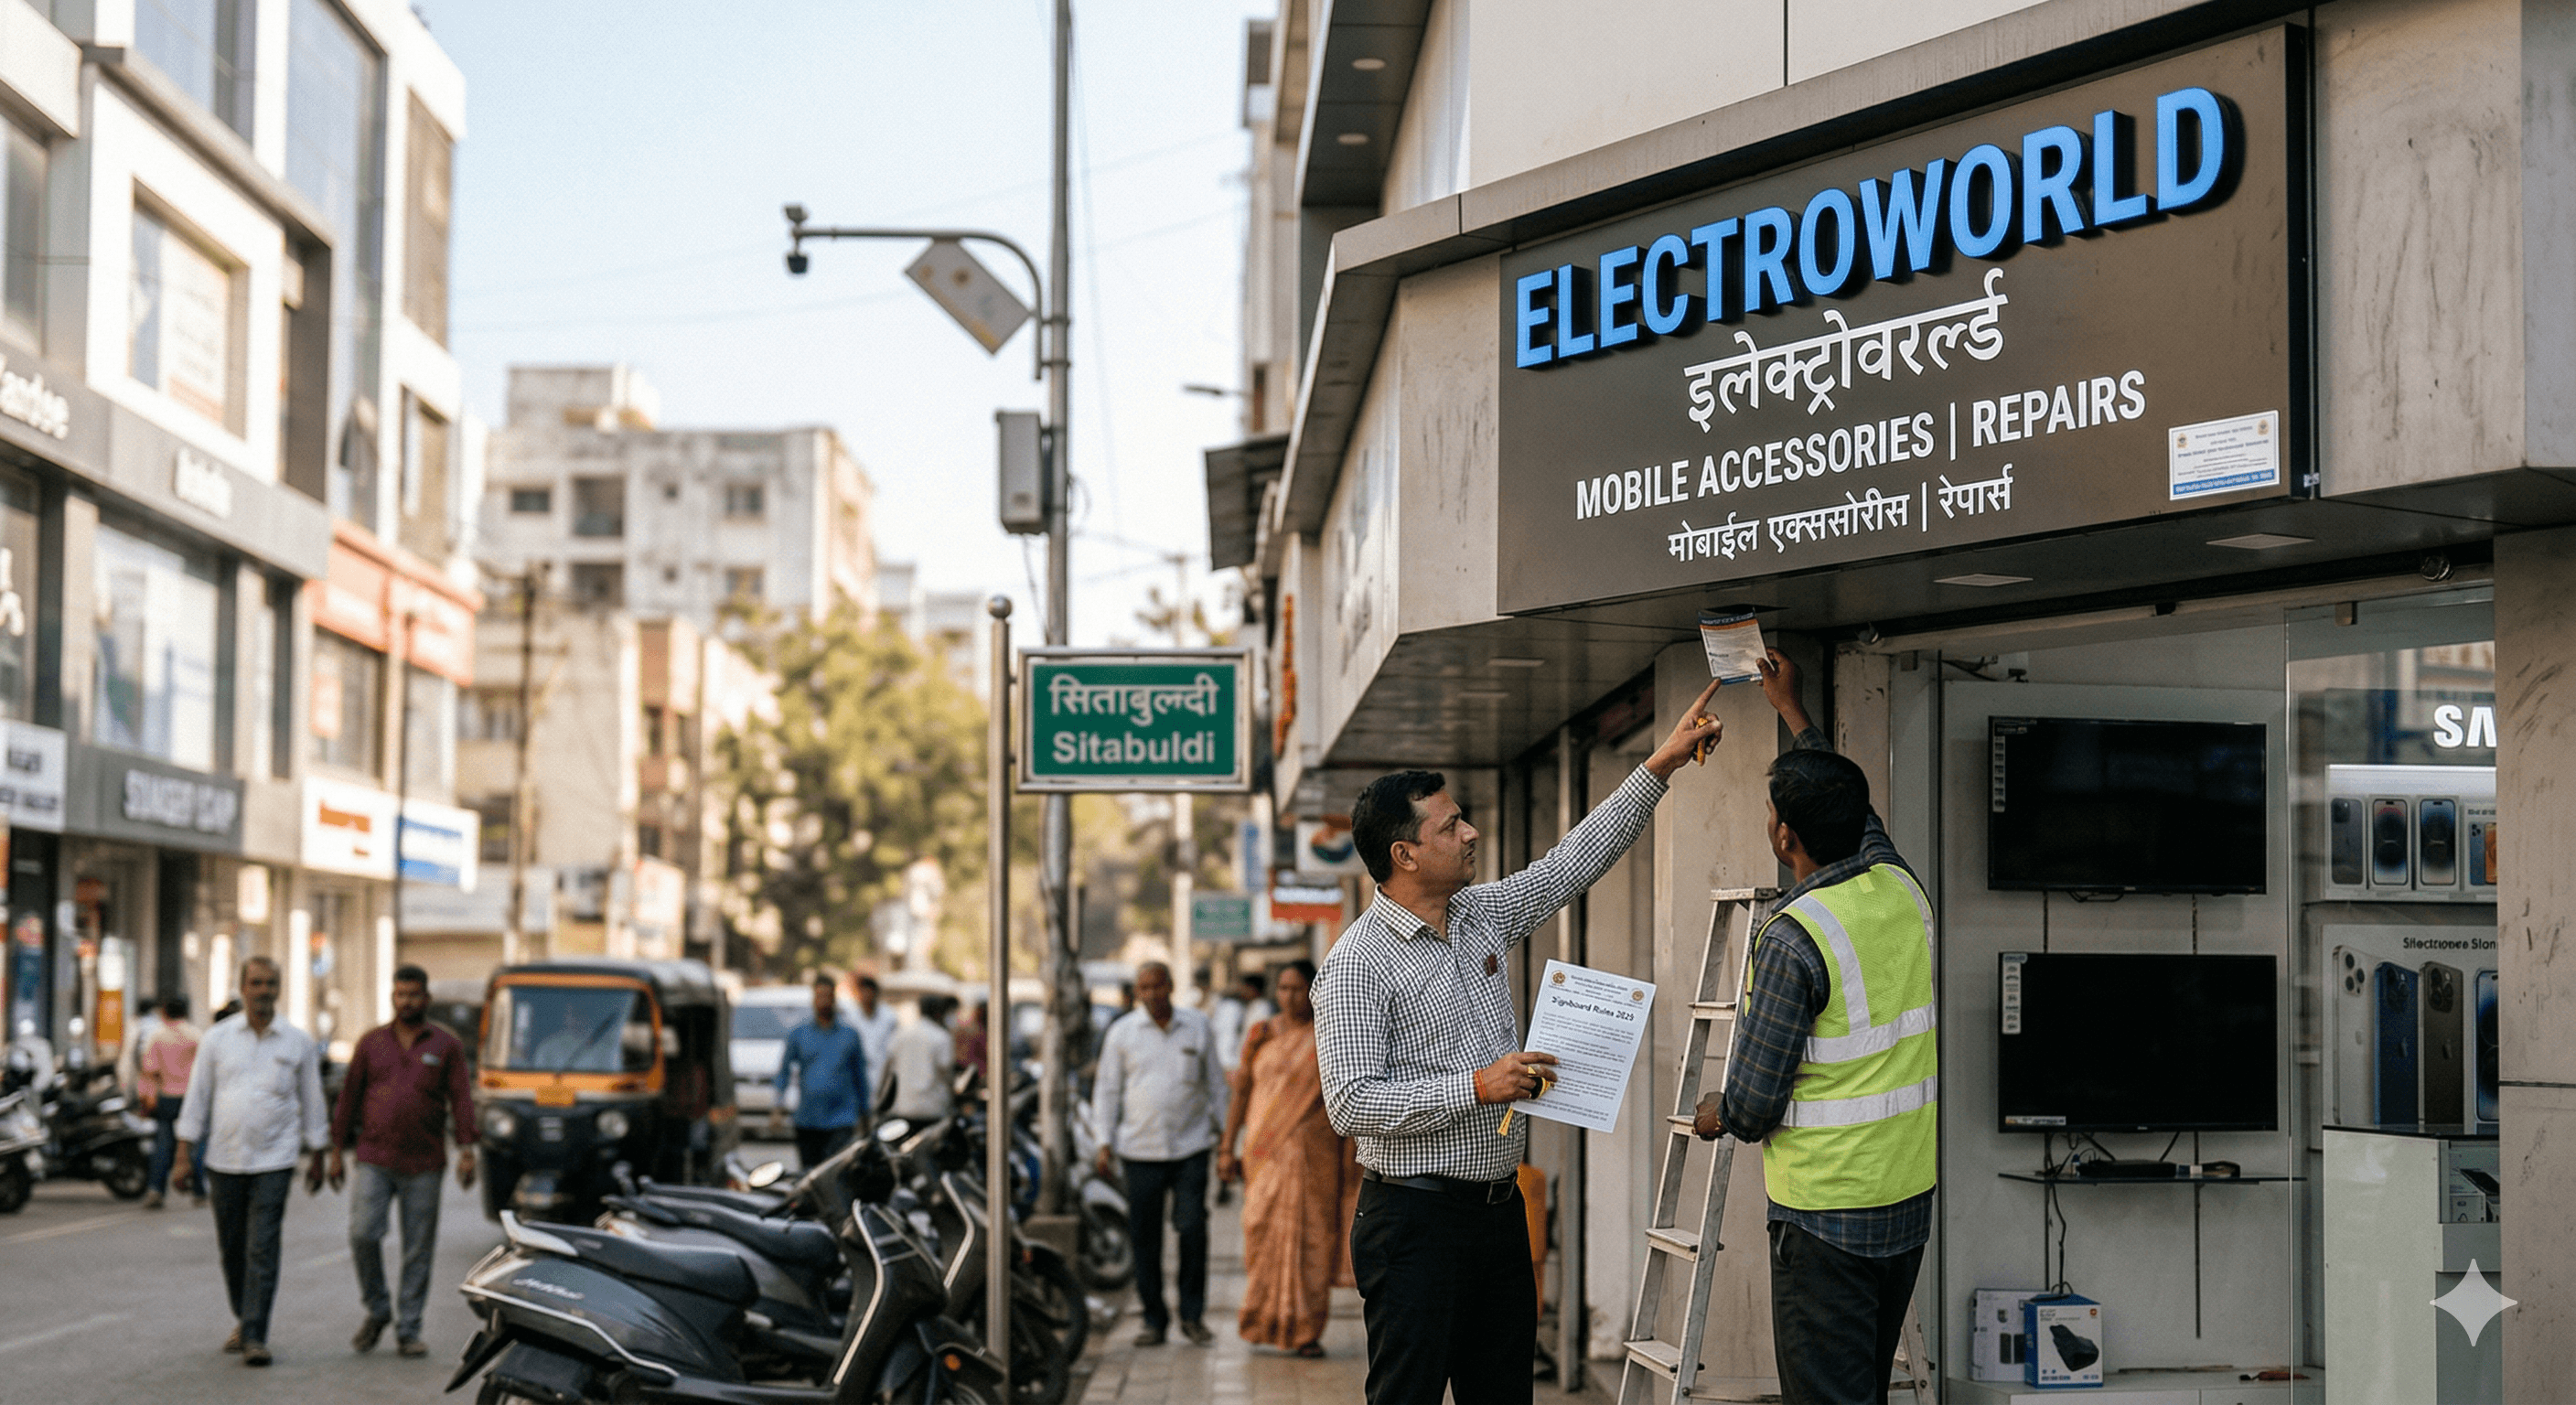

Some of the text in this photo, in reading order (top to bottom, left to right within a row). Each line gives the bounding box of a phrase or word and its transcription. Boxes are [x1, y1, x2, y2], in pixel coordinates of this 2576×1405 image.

[1516, 87, 2224, 369] ELECTROWORLD
[1576, 459, 1690, 520] MOBILE
[1697, 412, 1934, 498] ACCESSORIES
[1972, 370, 2145, 447] REPAIRS
[1668, 511, 1760, 562] मोबाईल
[1766, 488, 1911, 553] एक्ससोरीस
[1937, 463, 2013, 519] रेपार्स
[1053, 731, 1215, 763] Sitabuldi
